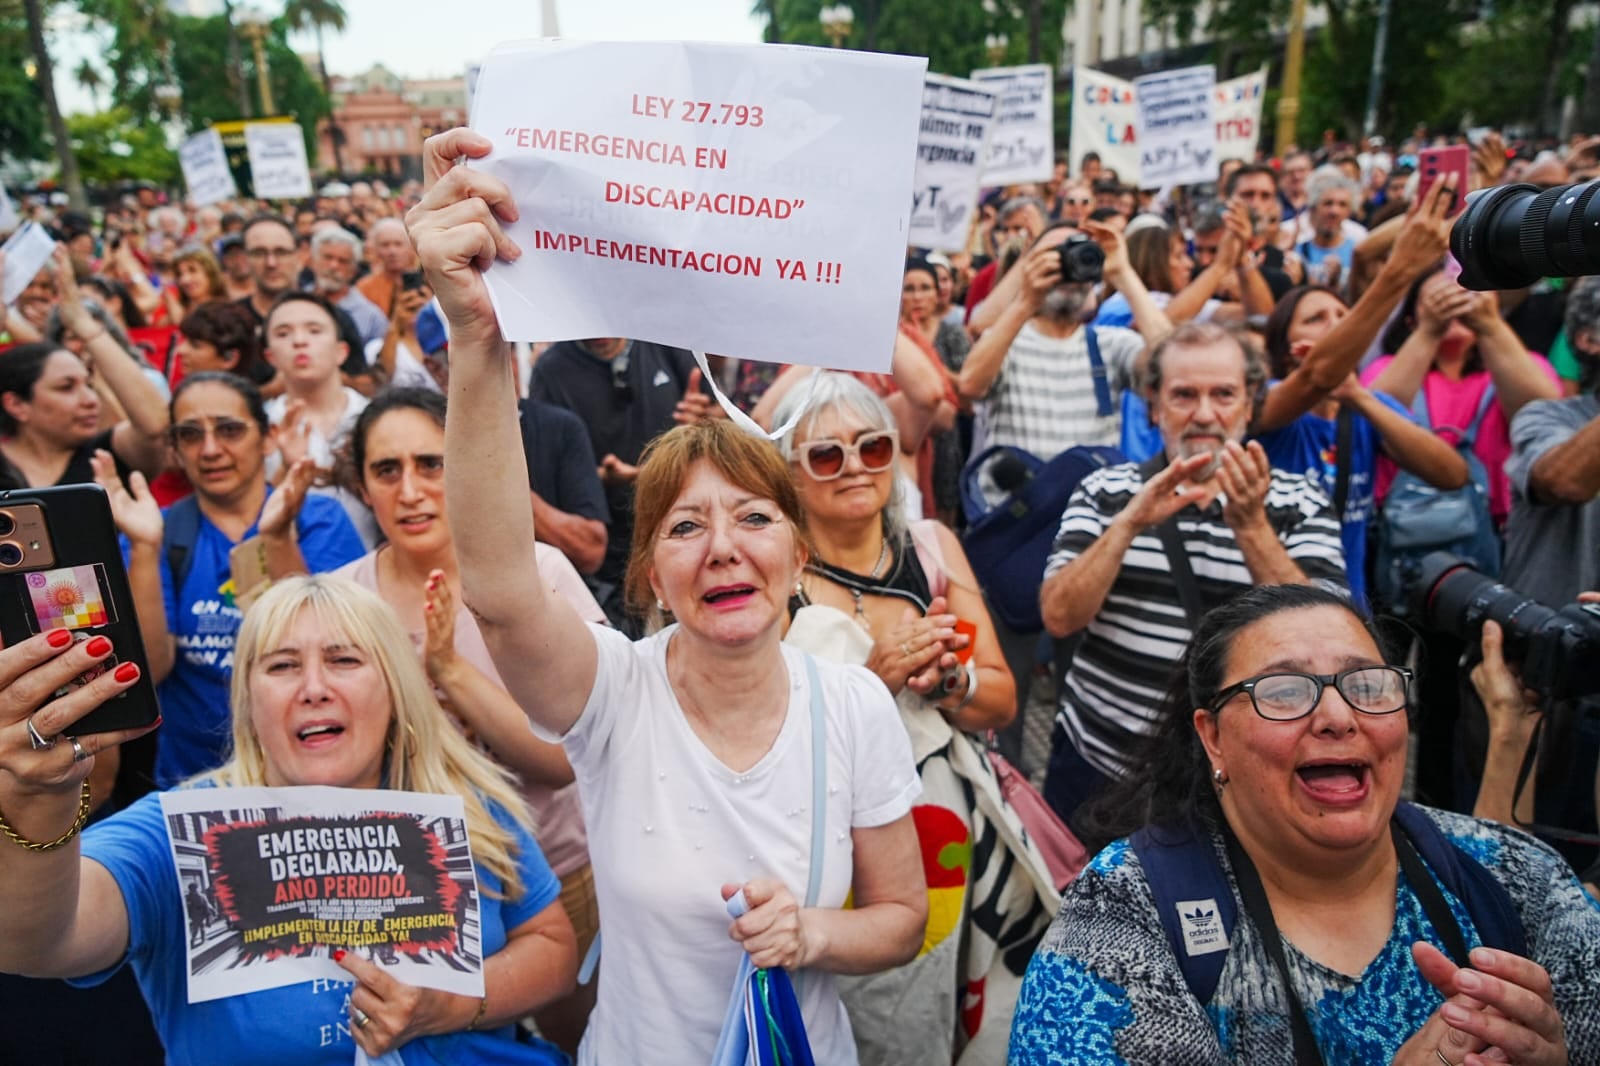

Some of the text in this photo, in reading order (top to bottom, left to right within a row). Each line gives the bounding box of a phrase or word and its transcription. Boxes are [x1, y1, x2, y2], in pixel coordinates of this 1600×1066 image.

[631, 94, 764, 127] LEY 27.793
[505, 127, 727, 169] “EMERGENCIA EN
[604, 181, 804, 220] DISCAPACIDAD”
[535, 230, 842, 284] IMPLEMENTACION YA !!!
[258, 825, 401, 859] EMERGENCIA
[270, 849, 405, 882] DECLARADA,
[325, 873, 411, 899] PERDIDO,
[298, 930, 410, 947] EN DISCAPACIDAD YA!
[328, 920, 340, 934] LA
[342, 920, 360, 934] LEY
[364, 920, 377, 933] DE
[383, 914, 455, 932] EMERGENCIA
[1189, 928, 1219, 937] adidas
